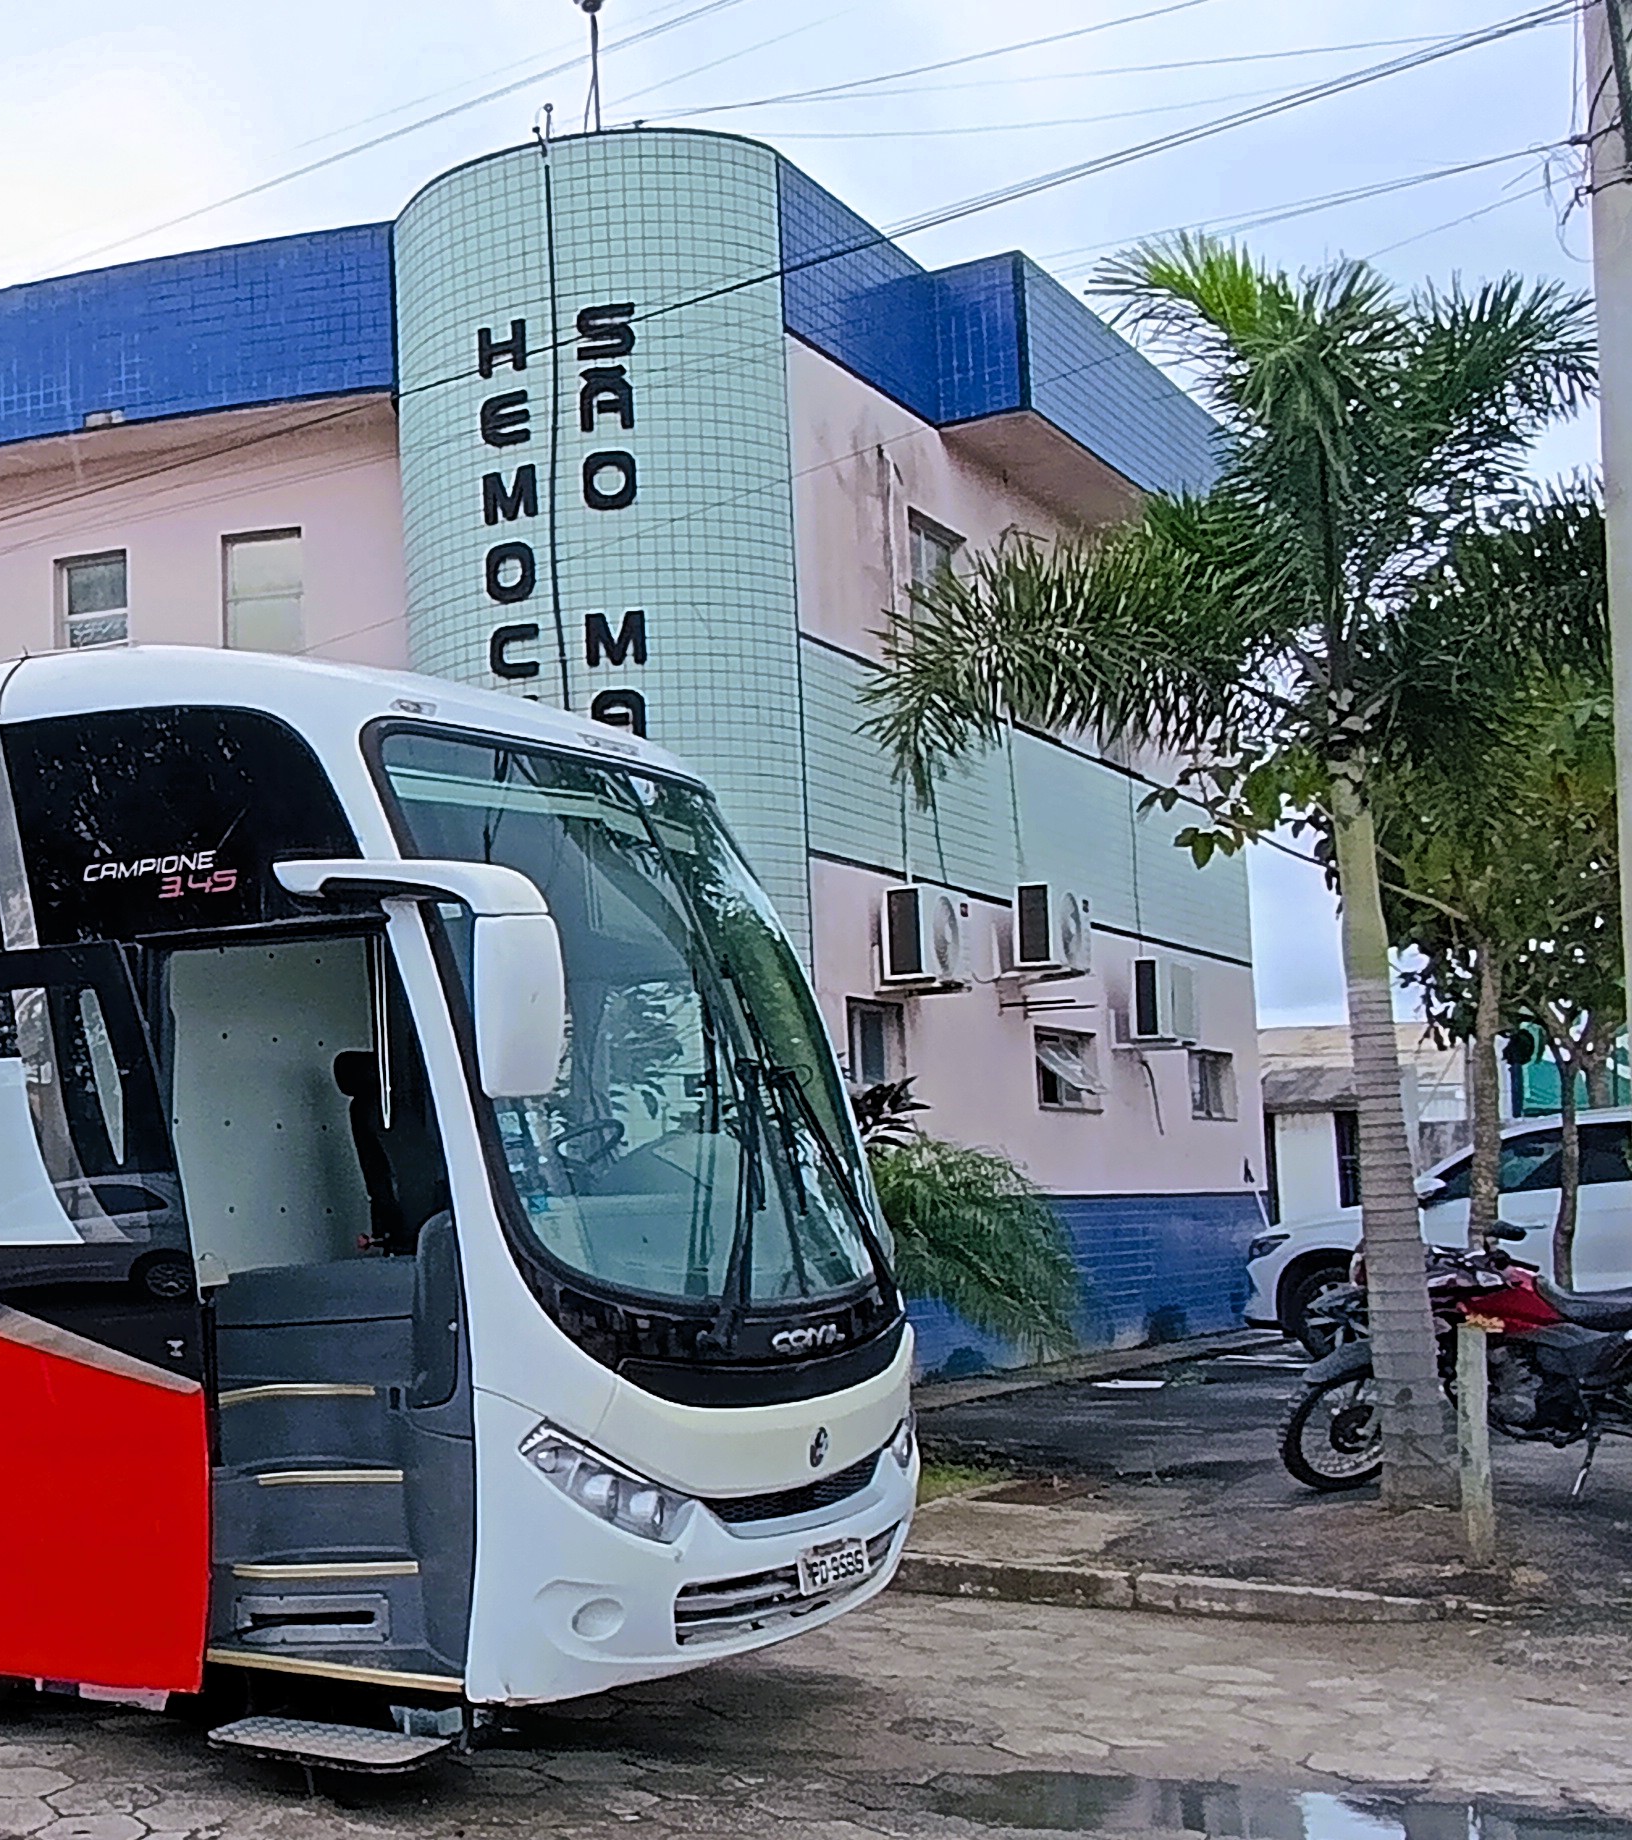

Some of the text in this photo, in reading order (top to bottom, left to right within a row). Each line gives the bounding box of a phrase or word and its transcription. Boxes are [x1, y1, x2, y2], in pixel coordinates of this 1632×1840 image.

[576, 302, 638, 512] SÃO
[477, 318, 540, 702] HEMOC
[83, 850, 217, 882] CAMPIONE
[158, 869, 238, 899] 3.45
